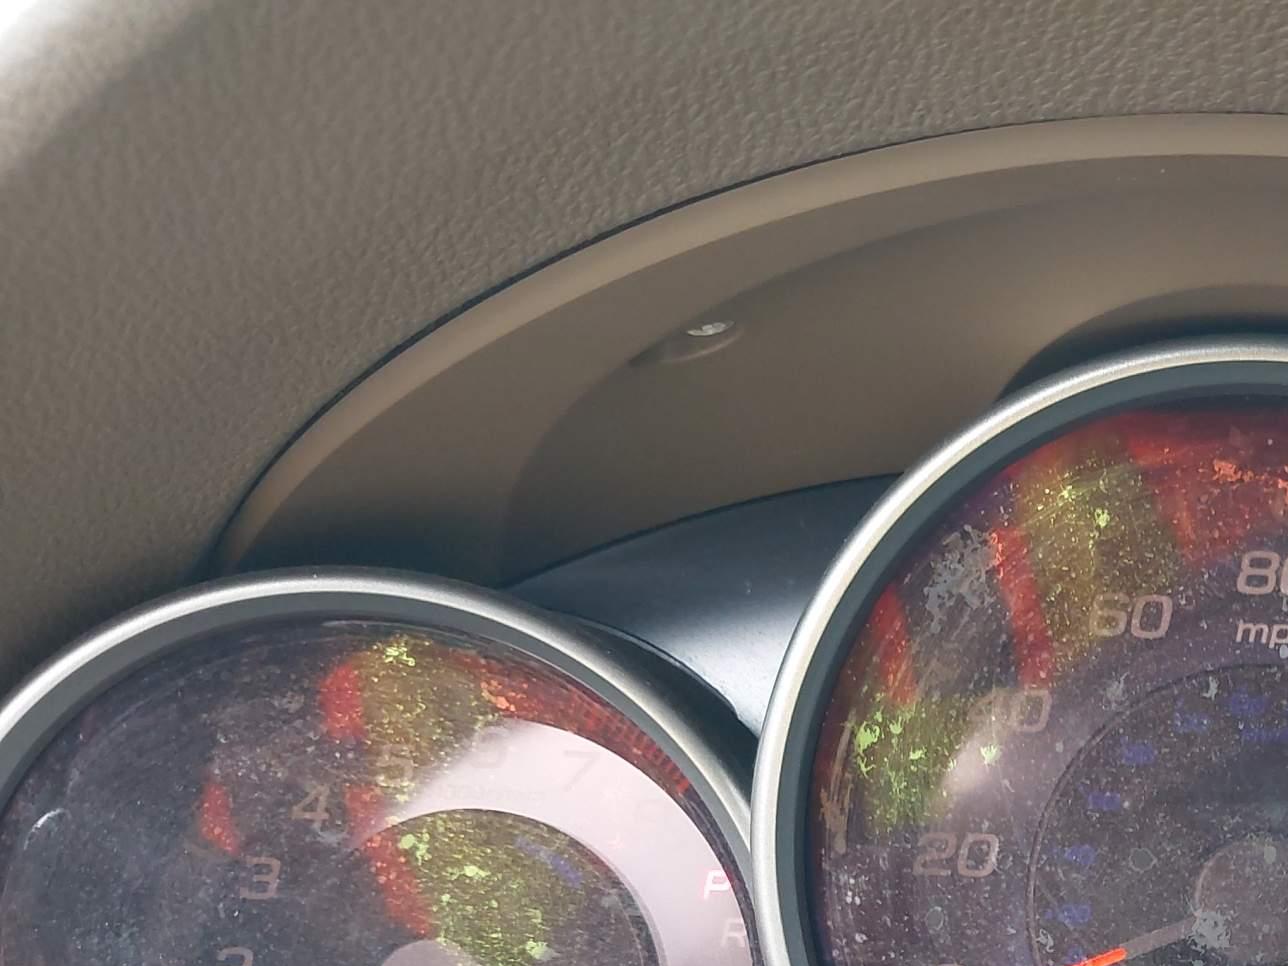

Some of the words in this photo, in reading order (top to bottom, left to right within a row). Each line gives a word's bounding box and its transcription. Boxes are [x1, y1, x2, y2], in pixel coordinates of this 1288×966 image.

[1091, 591, 1173, 639] 60
[291, 783, 331, 833] 4
[912, 832, 999, 877] 20
[239, 856, 282, 900] 3
[703, 869, 733, 901] P
[720, 917, 747, 947] R
